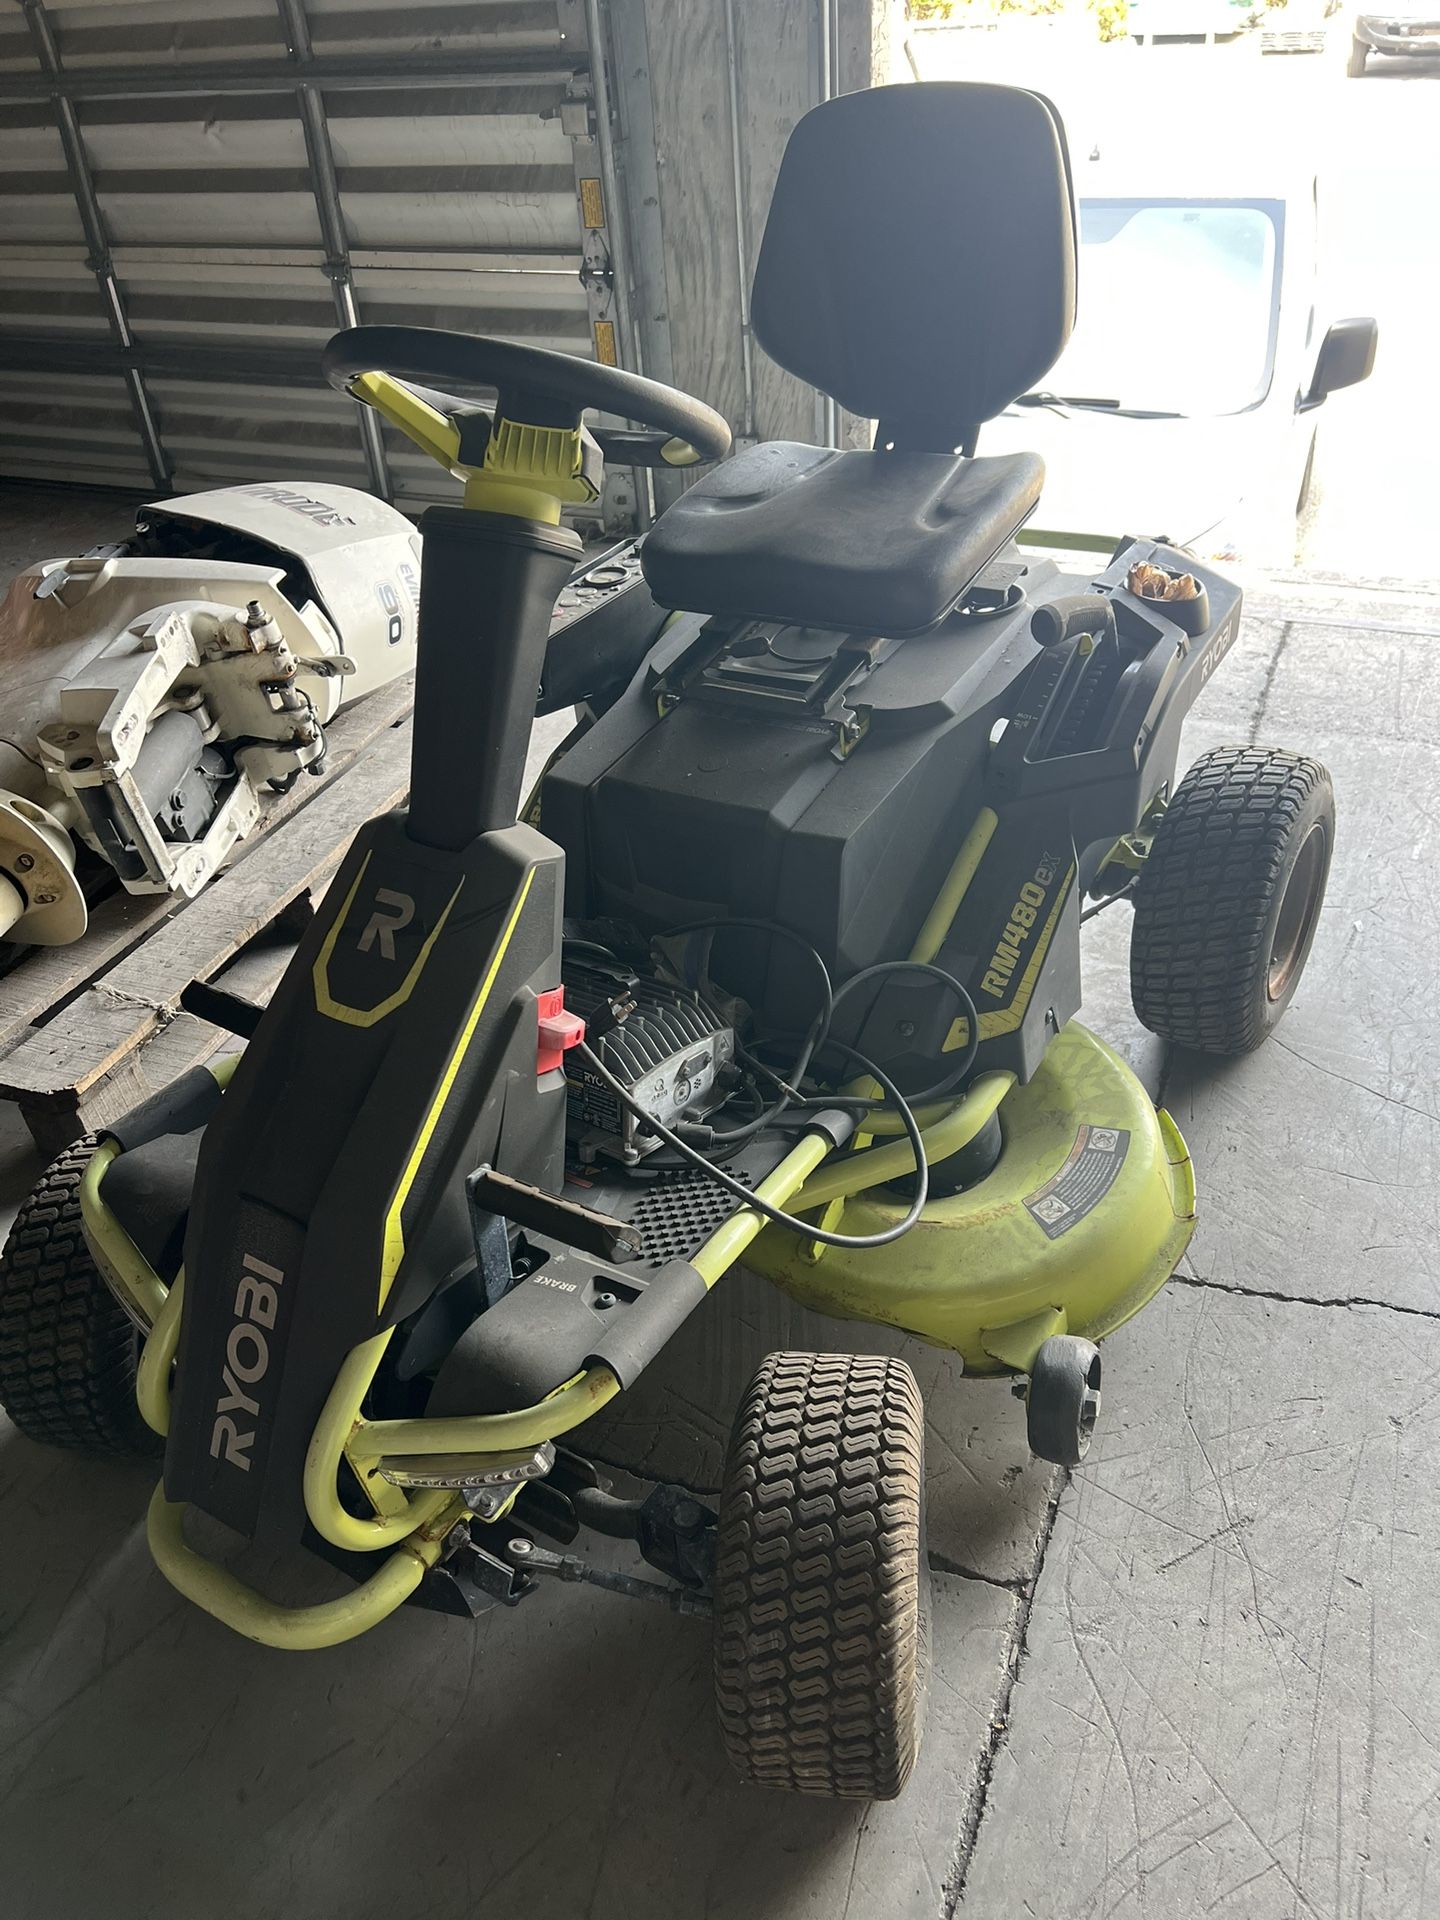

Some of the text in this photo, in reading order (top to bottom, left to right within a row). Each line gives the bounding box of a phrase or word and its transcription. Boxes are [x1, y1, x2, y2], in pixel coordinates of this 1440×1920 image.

[1201, 620, 1233, 682] RYOBI
[357, 888, 415, 960] R
[533, 1275, 577, 1292] BRAKE
[210, 1253, 285, 1472] RYOBI
